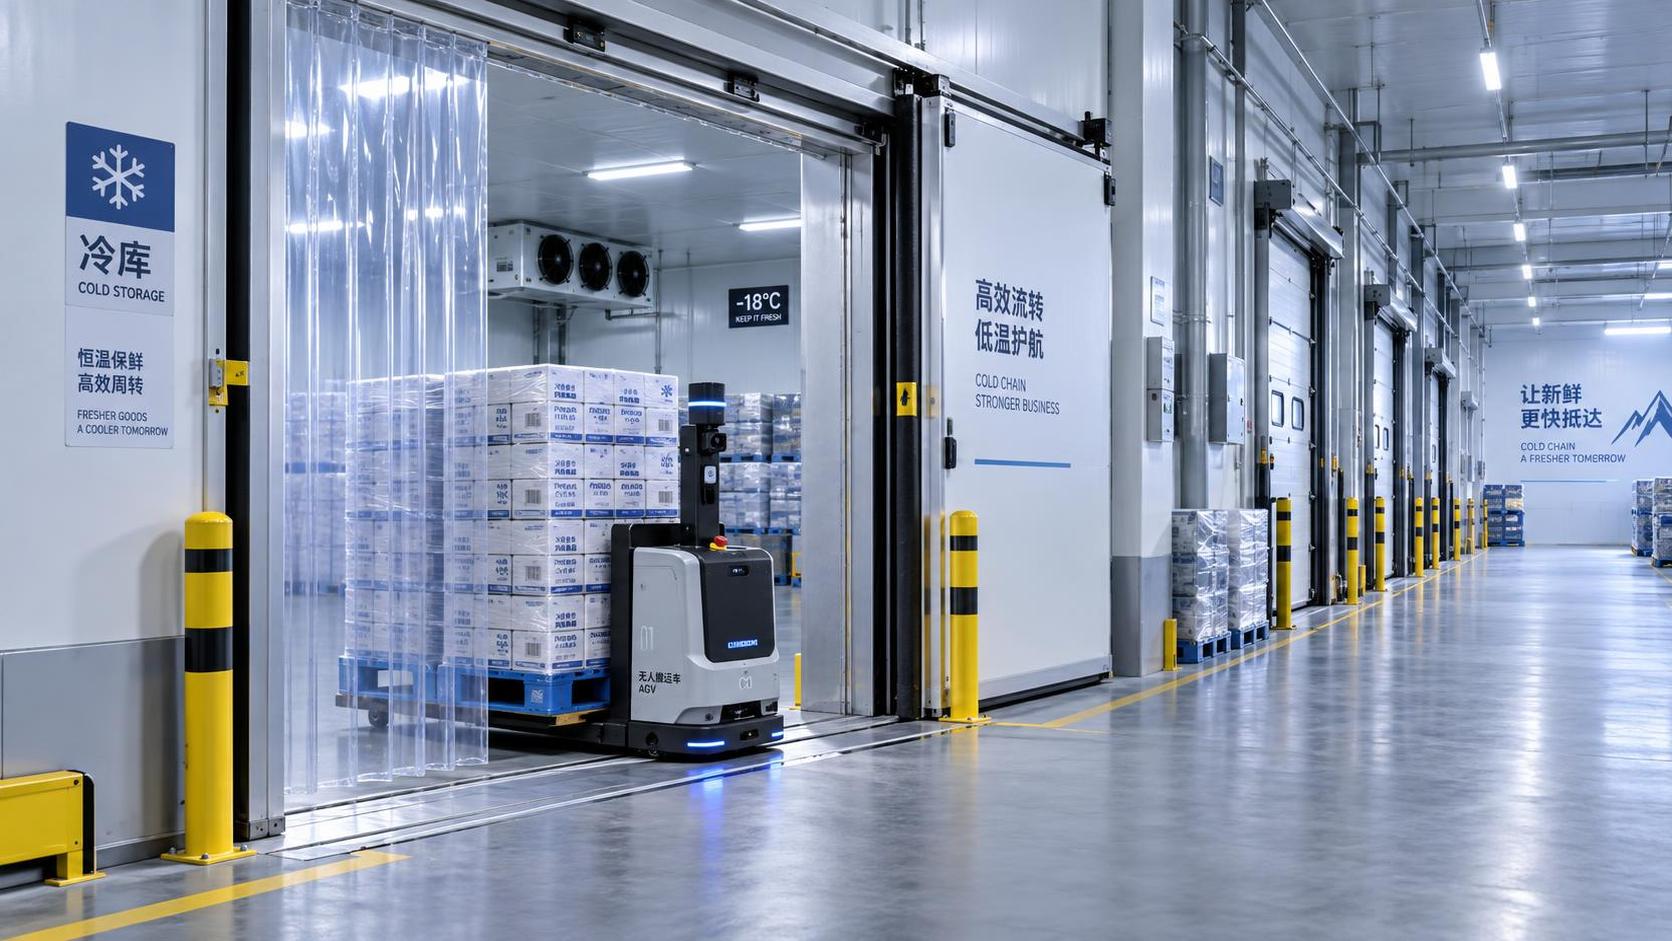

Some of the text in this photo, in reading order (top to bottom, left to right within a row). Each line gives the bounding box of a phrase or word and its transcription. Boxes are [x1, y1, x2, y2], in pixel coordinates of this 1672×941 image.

[79, 233, 152, 280] 冷库
[78, 281, 165, 303] COLD STORAGE
[975, 278, 1044, 322] 高效流转
[761, 313, 782, 321] FRESH
[974, 318, 1044, 360] 低温护航
[77, 347, 144, 371] 恒温保鲜
[77, 373, 144, 396] 高效周转
[975, 373, 1027, 393] COLD CHAIN
[1520, 383, 1583, 405] 让新鲜
[77, 409, 148, 422] FRESHER GOODS
[975, 393, 1060, 416] STRONGER BUSINESS
[1520, 407, 1603, 429] 更快抵达
[77, 424, 169, 436] A COOLER TOMORROW
[1520, 441, 1576, 452] COLD CHAIN
[1520, 454, 1528, 463] A
[1529, 453, 1570, 463] FRESHER
[638, 684, 656, 694] AGV
